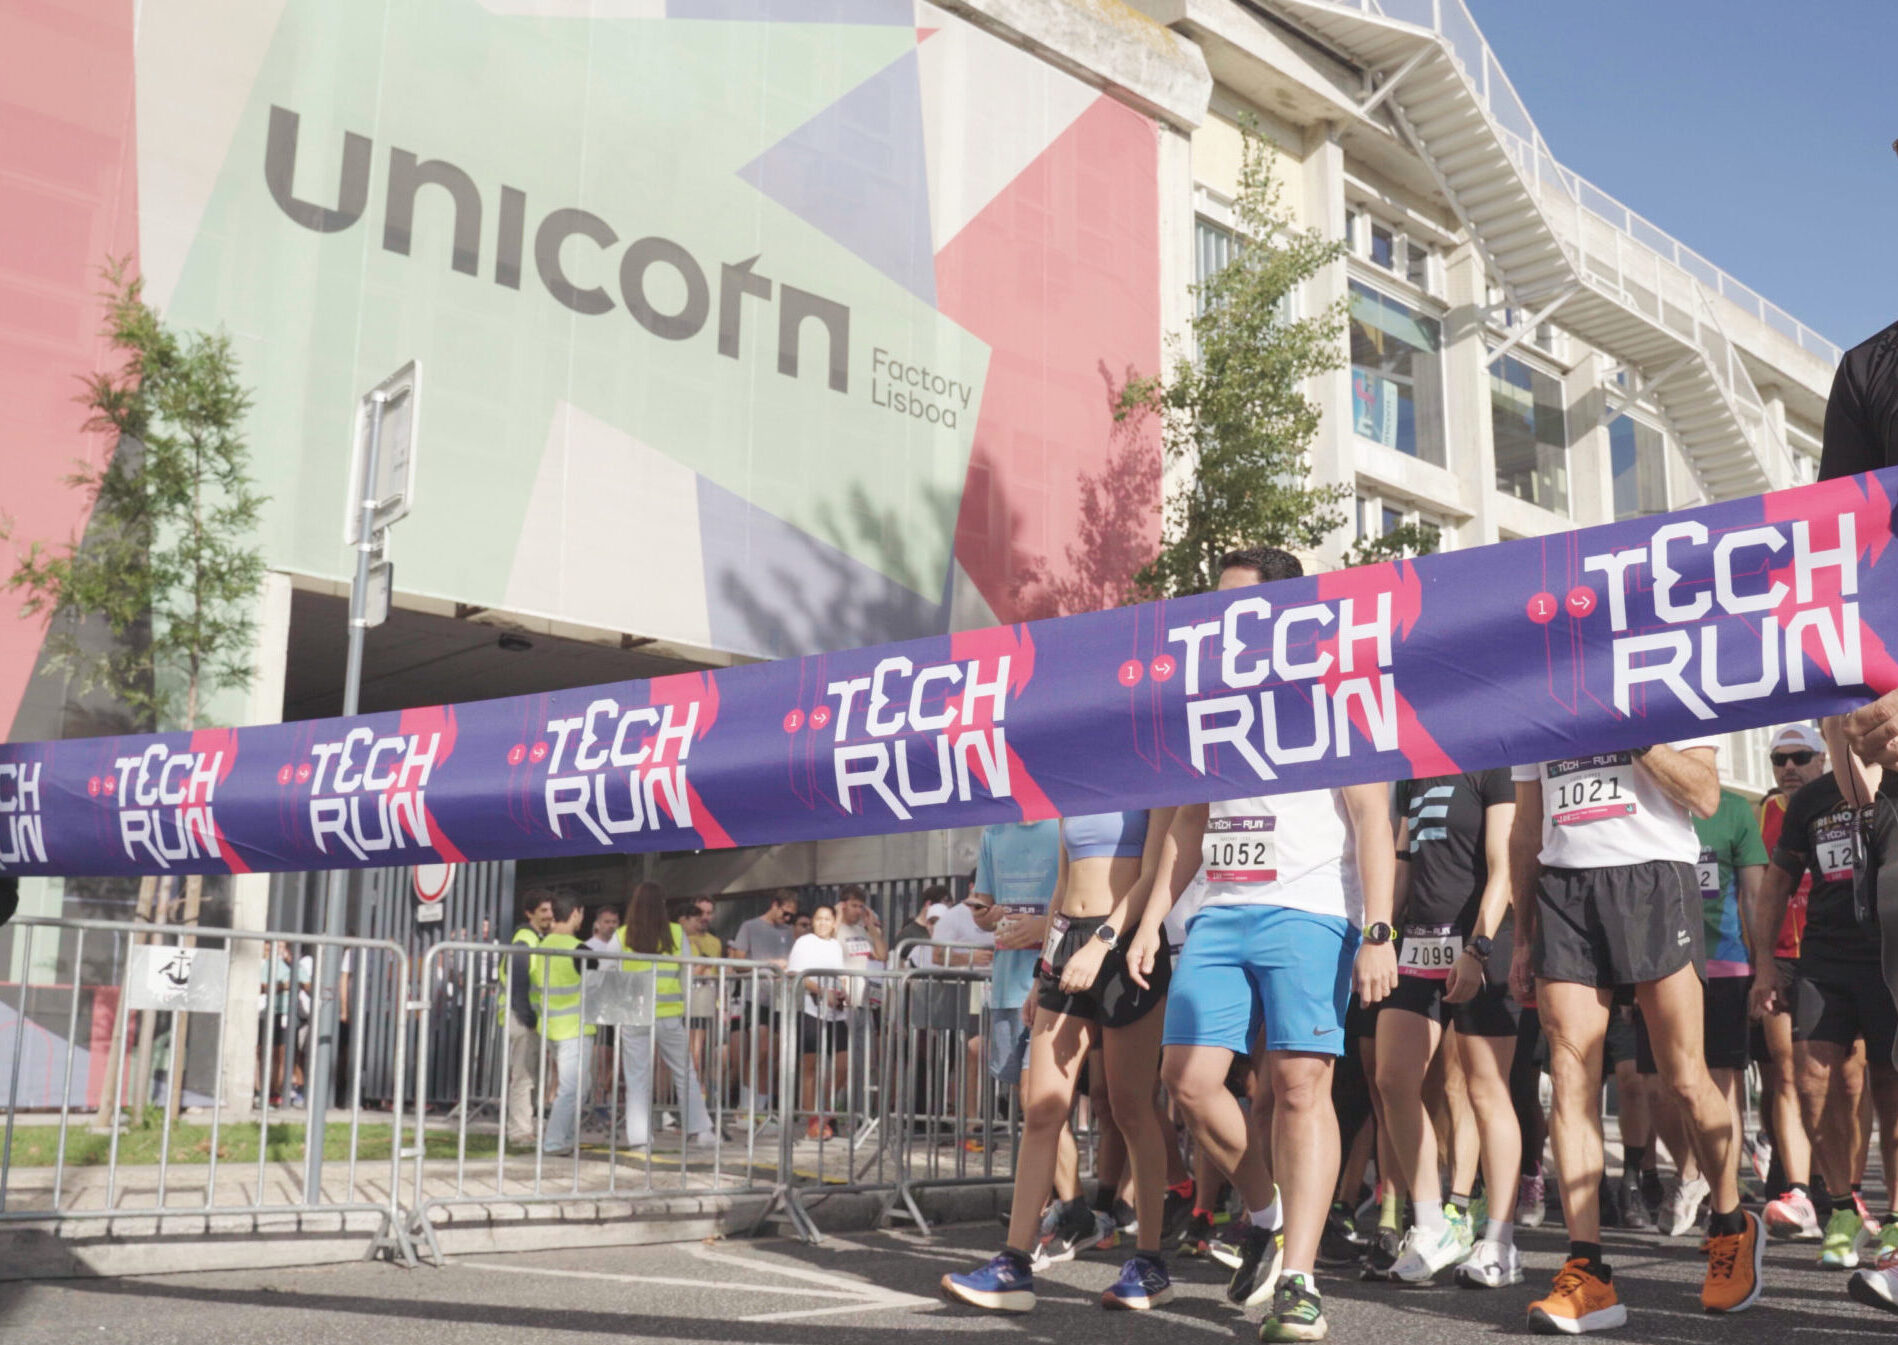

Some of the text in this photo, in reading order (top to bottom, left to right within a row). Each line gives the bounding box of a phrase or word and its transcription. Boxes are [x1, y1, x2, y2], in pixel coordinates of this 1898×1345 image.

[872, 377, 957, 430] Lisboa
[873, 347, 972, 409] Factory
[1584, 511, 1859, 632] TECH
[1167, 591, 1393, 696] TECH
[1613, 600, 1864, 720] RUN
[827, 655, 1012, 743] TECH
[1186, 674, 1399, 781] RUN
[311, 727, 441, 796] TECH
[546, 698, 701, 776] TECH
[1593, 754, 1617, 766] RUN
[0, 762, 42, 811] CH
[115, 743, 224, 808] TECH
[544, 764, 694, 846] RUN
[834, 726, 1012, 821] RUN
[1558, 776, 1621, 810] 1021
[0, 814, 48, 866] UN
[119, 806, 222, 869] RUN
[310, 790, 432, 862] RUN
[1210, 842, 1266, 867] 1052
[1243, 820, 1263, 830] RUN
[1827, 847, 1853, 869] 12
[1407, 946, 1454, 966] 1099
